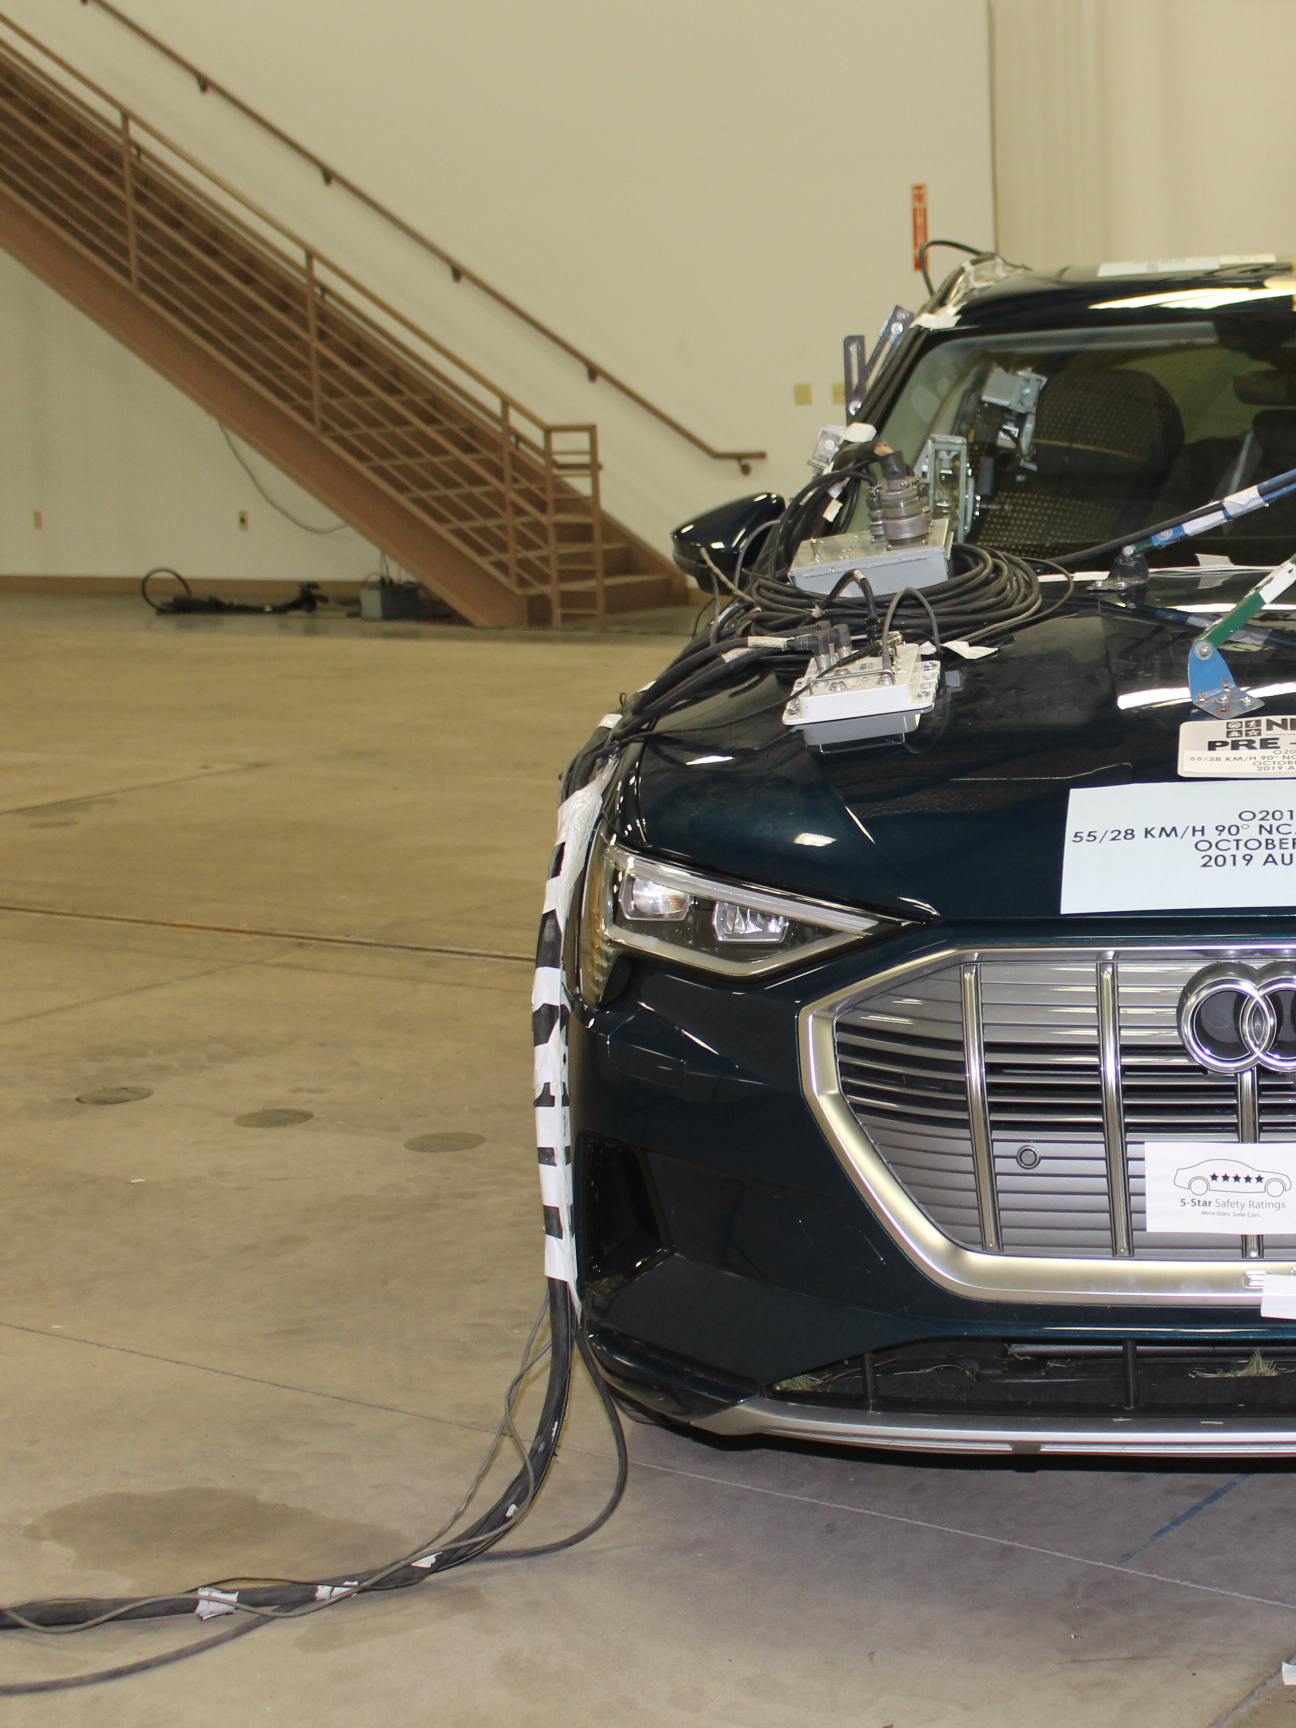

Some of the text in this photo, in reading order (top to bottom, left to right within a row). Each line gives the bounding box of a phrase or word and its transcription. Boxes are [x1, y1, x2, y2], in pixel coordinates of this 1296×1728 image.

[1207, 737, 1281, 751] PRE
[1071, 828, 1136, 844] 55/28
[1144, 825, 1206, 840] KM/H
[1200, 853, 1254, 868] 2019
[1180, 1198, 1286, 1212] 5-Star Safety Ratings
